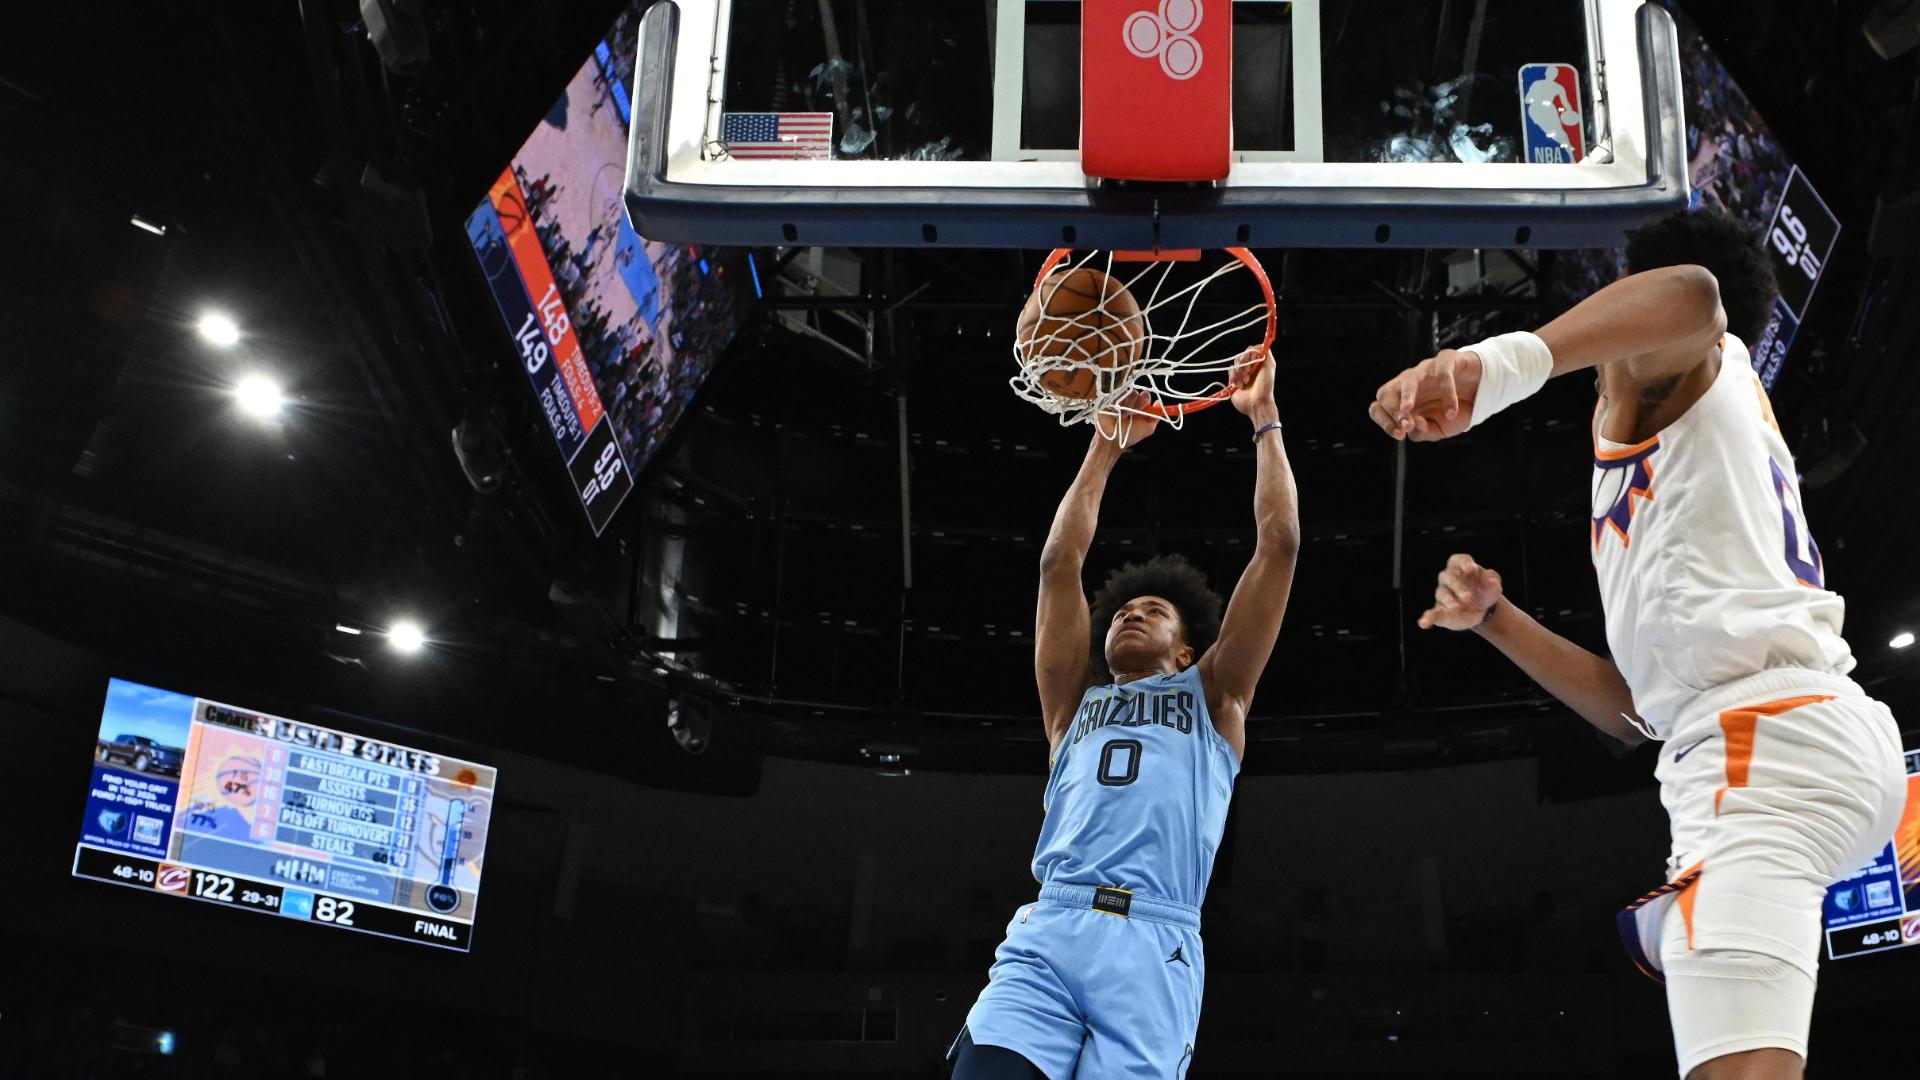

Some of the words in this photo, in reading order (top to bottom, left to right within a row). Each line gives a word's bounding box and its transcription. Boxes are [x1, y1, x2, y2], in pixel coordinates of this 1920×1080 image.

[1534, 147, 1563, 163] NBA
[1772, 205, 1807, 266] 9.6
[1800, 243, 1821, 280] OT
[537, 283, 569, 346] 148
[515, 312, 548, 374] 149
[594, 441, 622, 491] 9.6
[583, 478, 600, 506] OT
[1073, 691, 1193, 744] GRIZZLIES
[300, 755, 365, 784] FASTBREAK
[367, 771, 390, 789] PTS
[1097, 739, 1142, 786] 0
[318, 778, 367, 801] ASSISTS
[305, 794, 374, 822] TURNOVERS
[281, 809, 303, 826] PTS
[304, 814, 325, 830] OFF
[327, 817, 390, 844] TURNOVERS
[311, 834, 355, 856] STEALS
[113, 865, 154, 883] 48-10
[196, 872, 235, 902] 122
[241, 890, 279, 907] 29-31
[316, 897, 355, 926] 82
[415, 920, 457, 941] FINAL
[1862, 929, 1899, 945] 48-10
